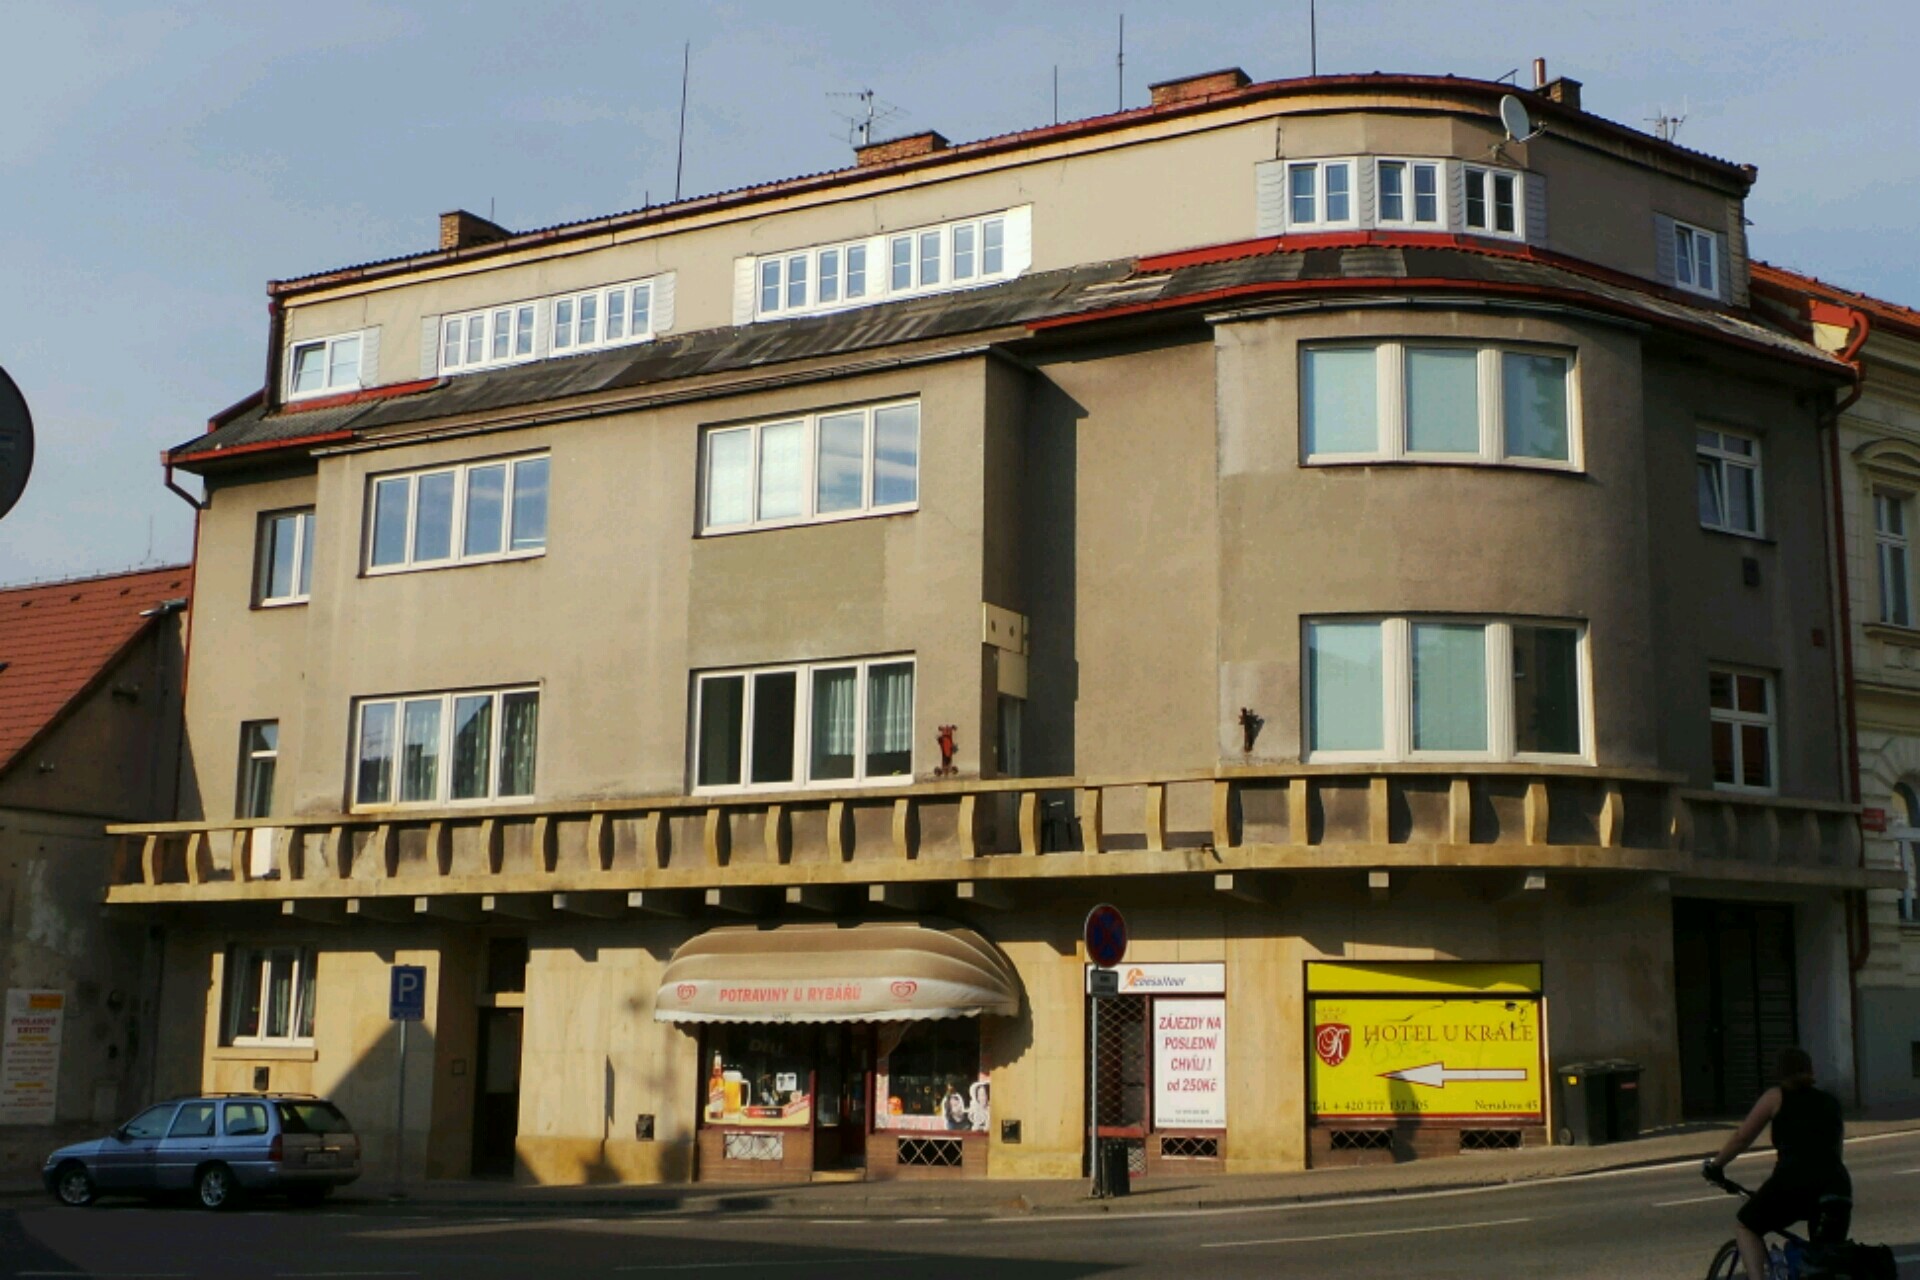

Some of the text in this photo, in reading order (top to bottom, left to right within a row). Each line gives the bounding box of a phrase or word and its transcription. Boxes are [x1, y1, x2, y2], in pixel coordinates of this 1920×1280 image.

[398, 973, 418, 1002] P
[719, 987, 789, 1002] POTRAVINY
[793, 987, 802, 1001] U
[1159, 1013, 1222, 1030] ZÁJEZDY NA
[1363, 1021, 1534, 1042] HOTEL U KRÁLE
[1164, 1034, 1218, 1050] POSLEDNÍ
[1166, 1078, 1180, 1091] od
